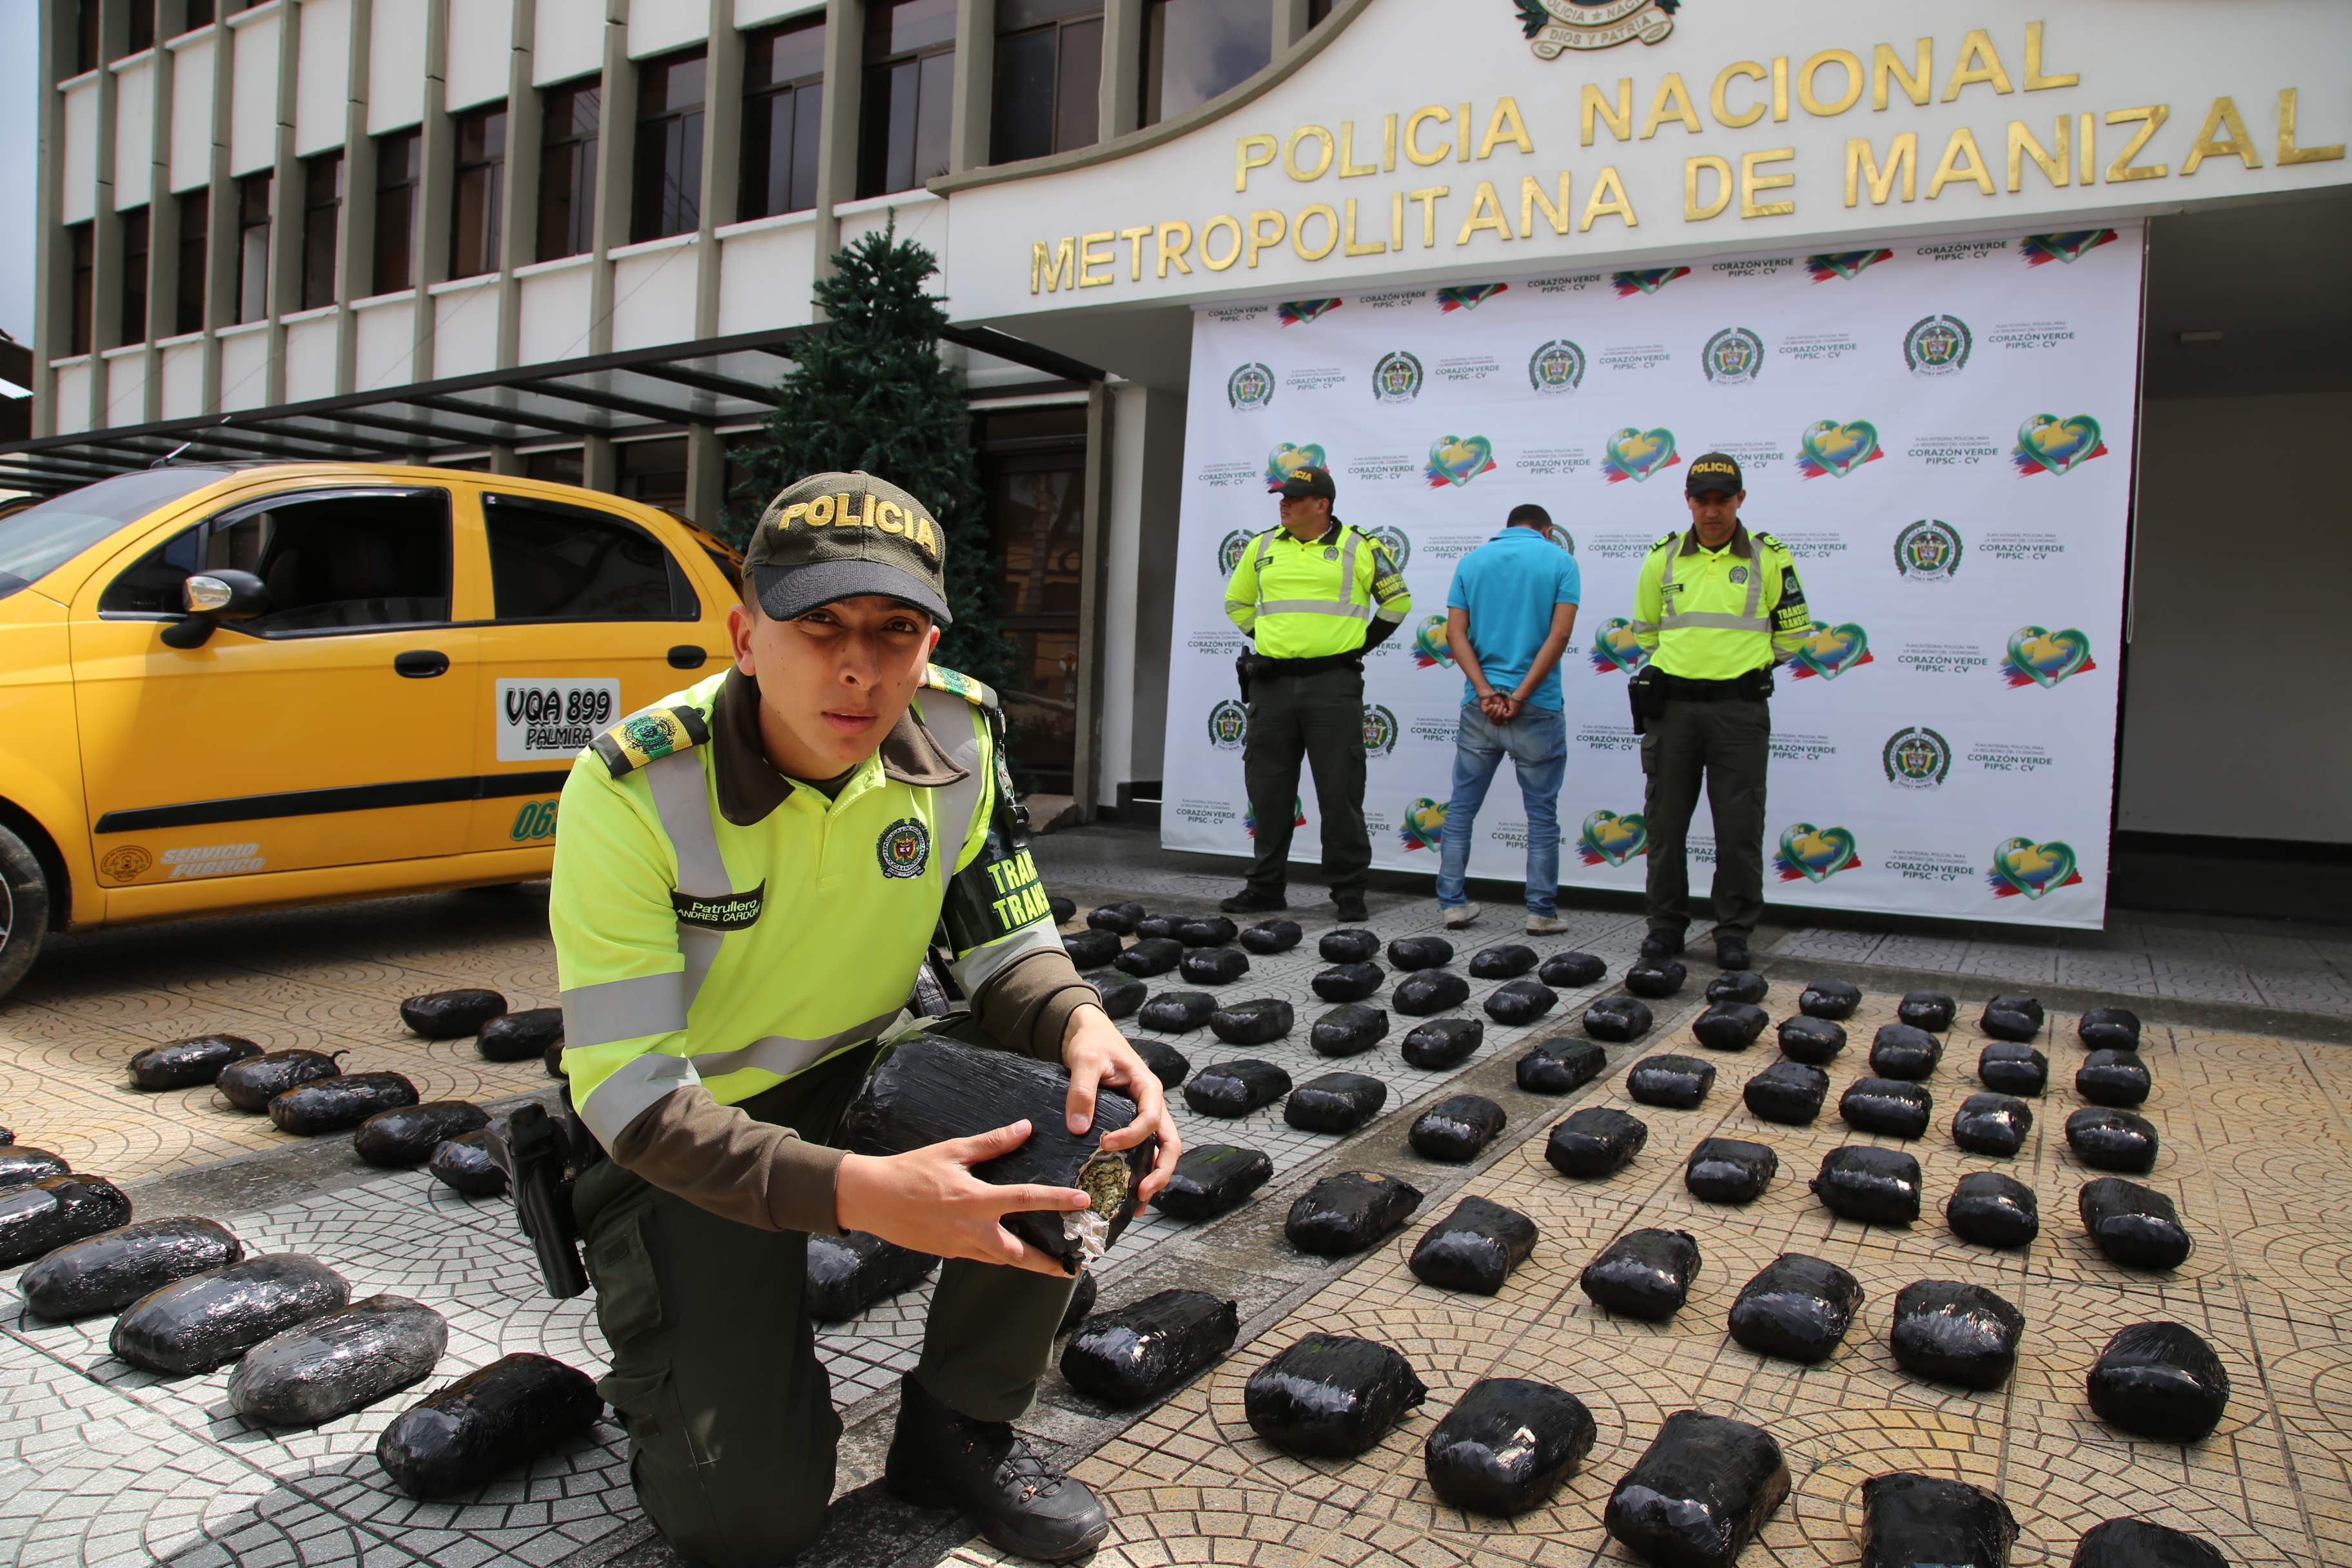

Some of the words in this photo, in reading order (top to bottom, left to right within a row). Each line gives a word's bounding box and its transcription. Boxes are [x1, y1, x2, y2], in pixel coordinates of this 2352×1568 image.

[1549, 30, 1582, 44] DIOS
[1588, 35, 1596, 45] Y
[1602, 15, 1651, 44] PATRIA
[1235, 96, 1534, 192] POLICIA
[1580, 21, 2079, 146] NACIONAL
[1032, 166, 1638, 295] METROPOLITANA
[1684, 147, 1795, 222] DE
[1844, 87, 2346, 208] MANIZAL
[1973, 241, 2006, 251] VERDE
[1762, 258, 1793, 267] VERDE
[1573, 274, 1601, 283] VERDE
[1729, 269, 1755, 277] PIPSC
[1690, 462, 1736, 475] POLICIA
[778, 493, 936, 556] POLICIA
[1954, 657, 1987, 665] VERDE
[566, 687, 613, 725] 899
[525, 724, 594, 750] PALMIRA
[2020, 757, 2052, 765] VERDE
[159, 843, 259, 865] SERVICIO
[1903, 872, 1932, 880] PIPSC
[1941, 865, 1974, 875] VERDE
[692, 900, 757, 914] Patrullero
[678, 909, 718, 921] ANDRES
